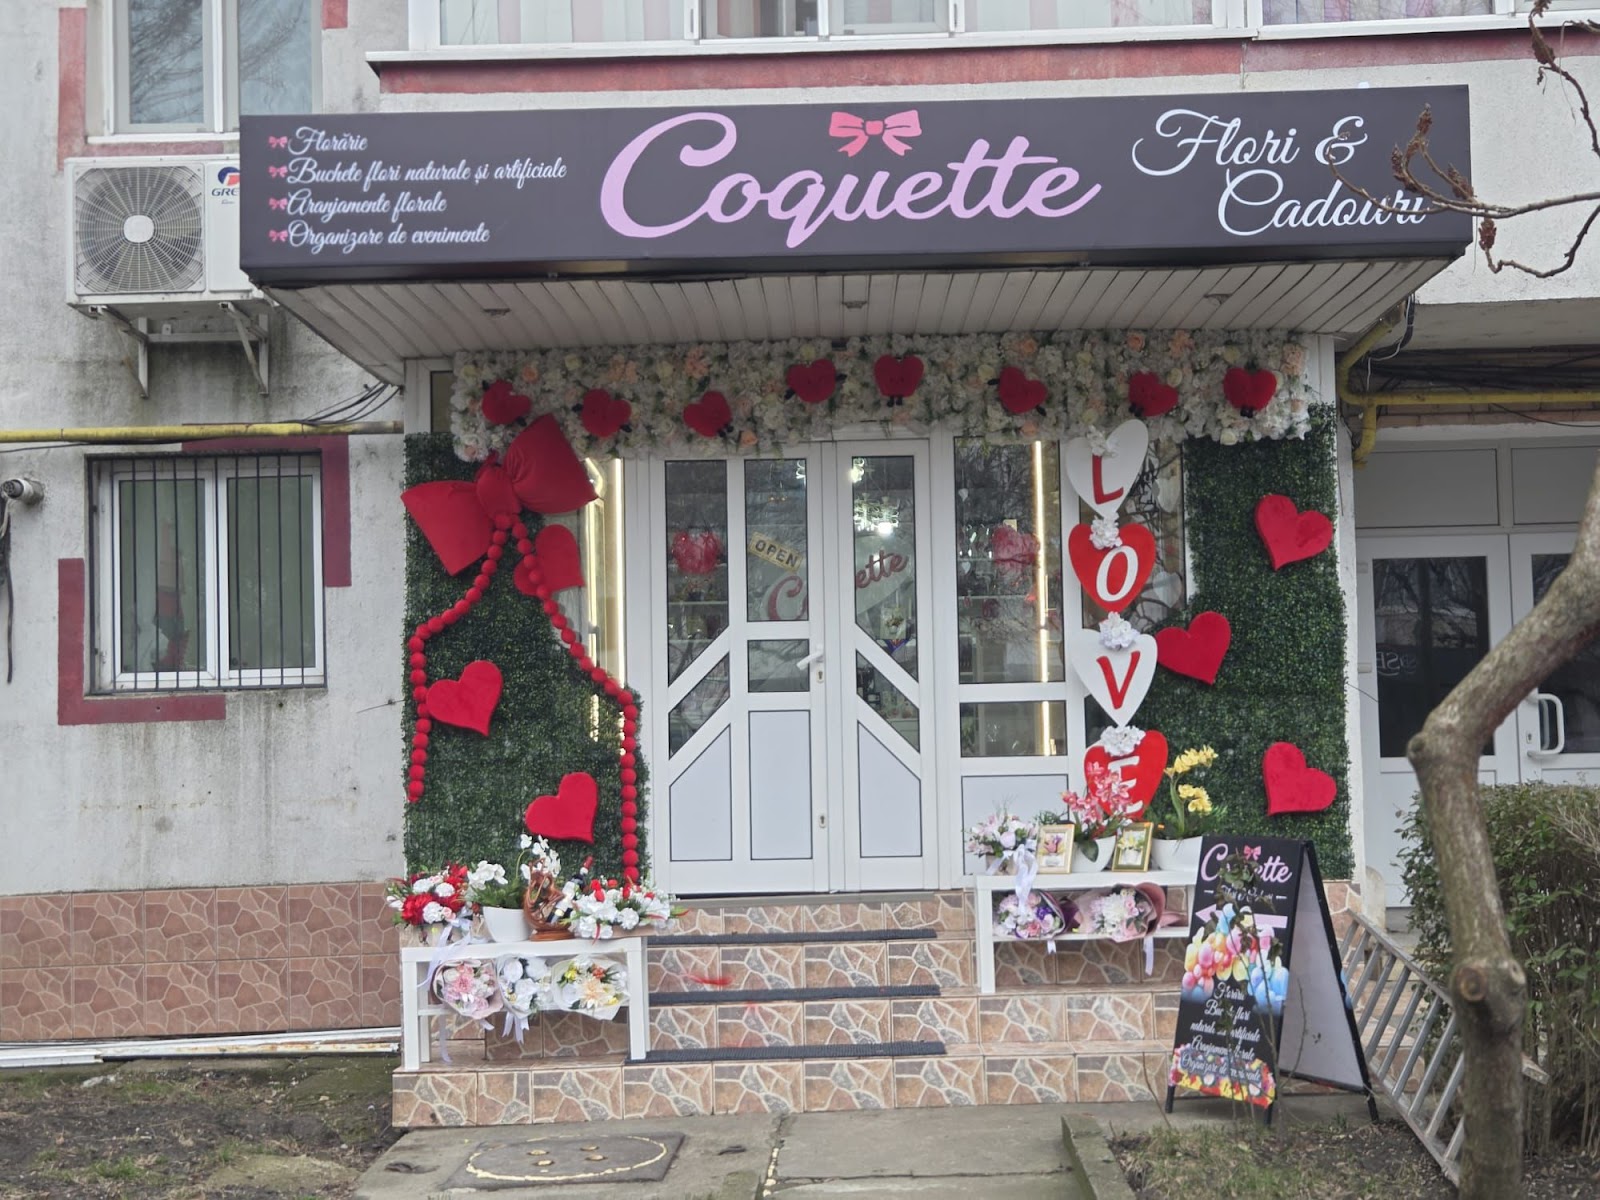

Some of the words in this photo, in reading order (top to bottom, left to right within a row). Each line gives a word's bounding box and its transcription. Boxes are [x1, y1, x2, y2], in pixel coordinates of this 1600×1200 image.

[288, 127, 368, 155] Florărie
[1131, 108, 1300, 177] Flori
[1314, 115, 1369, 166] &
[211, 187, 240, 197] GRE
[287, 157, 362, 184] Buchete
[363, 160, 401, 192] flori
[404, 159, 471, 182] naturale
[474, 162, 490, 185] și
[494, 156, 567, 189] artificiale
[600, 111, 1102, 249] Coquette
[286, 188, 391, 223] Aranjamente
[391, 190, 447, 223] florale
[1217, 168, 1430, 237] Cadouri
[288, 219, 384, 255] Organizare
[388, 223, 406, 244] de
[411, 222, 491, 244] evenimente
[754, 538, 800, 568] OPEN
